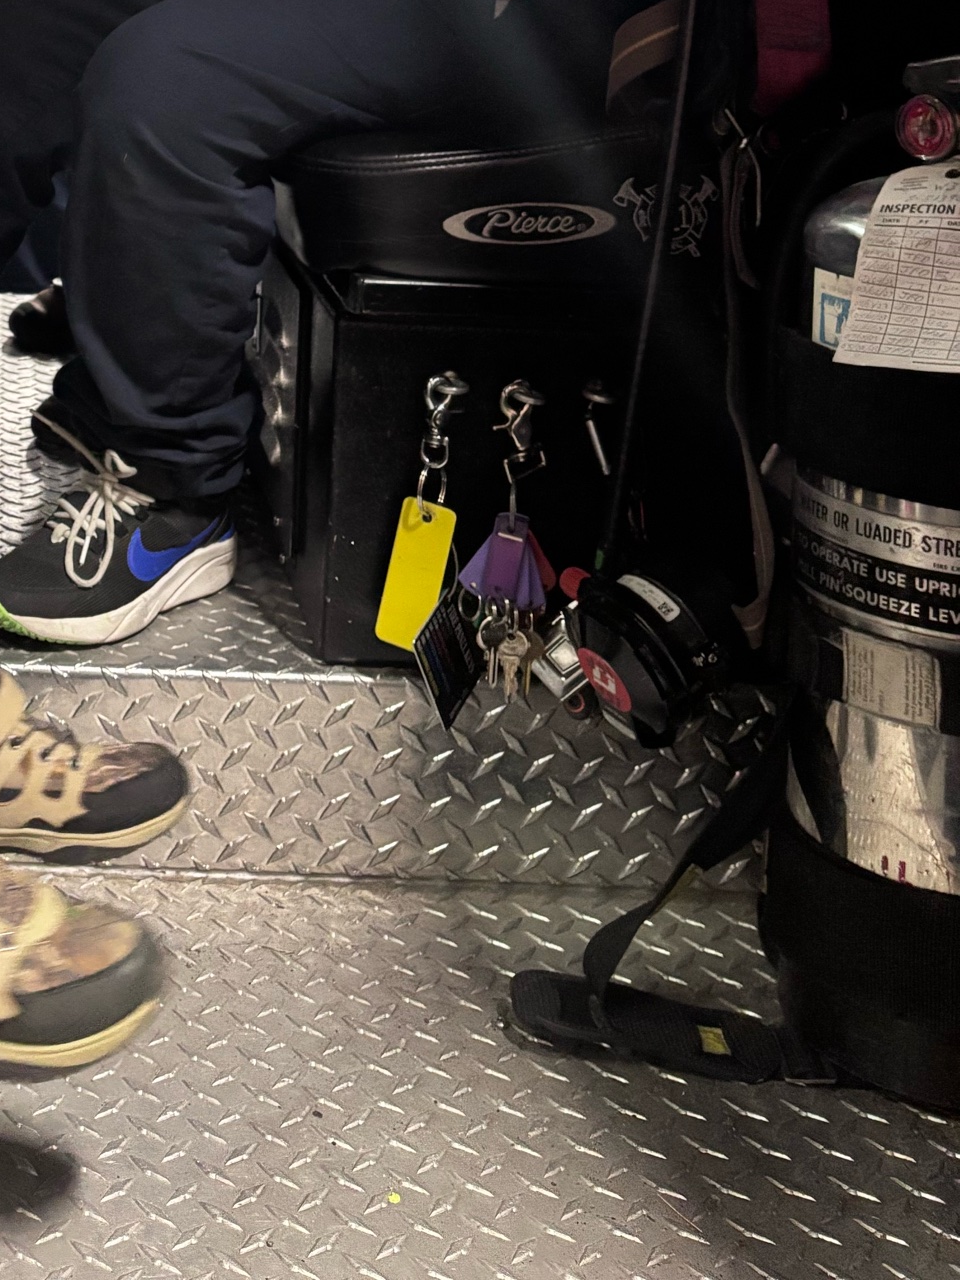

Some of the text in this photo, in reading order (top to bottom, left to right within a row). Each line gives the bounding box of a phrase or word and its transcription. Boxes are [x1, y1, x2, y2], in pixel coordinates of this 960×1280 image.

[481, 208, 577, 238] Pierce
[879, 203, 956, 215] INSPECTION
[833, 510, 849, 532] OR
[810, 540, 868, 578] OPERATE
[874, 566, 907, 588] USE
[843, 583, 921, 618] SQUEEZE
